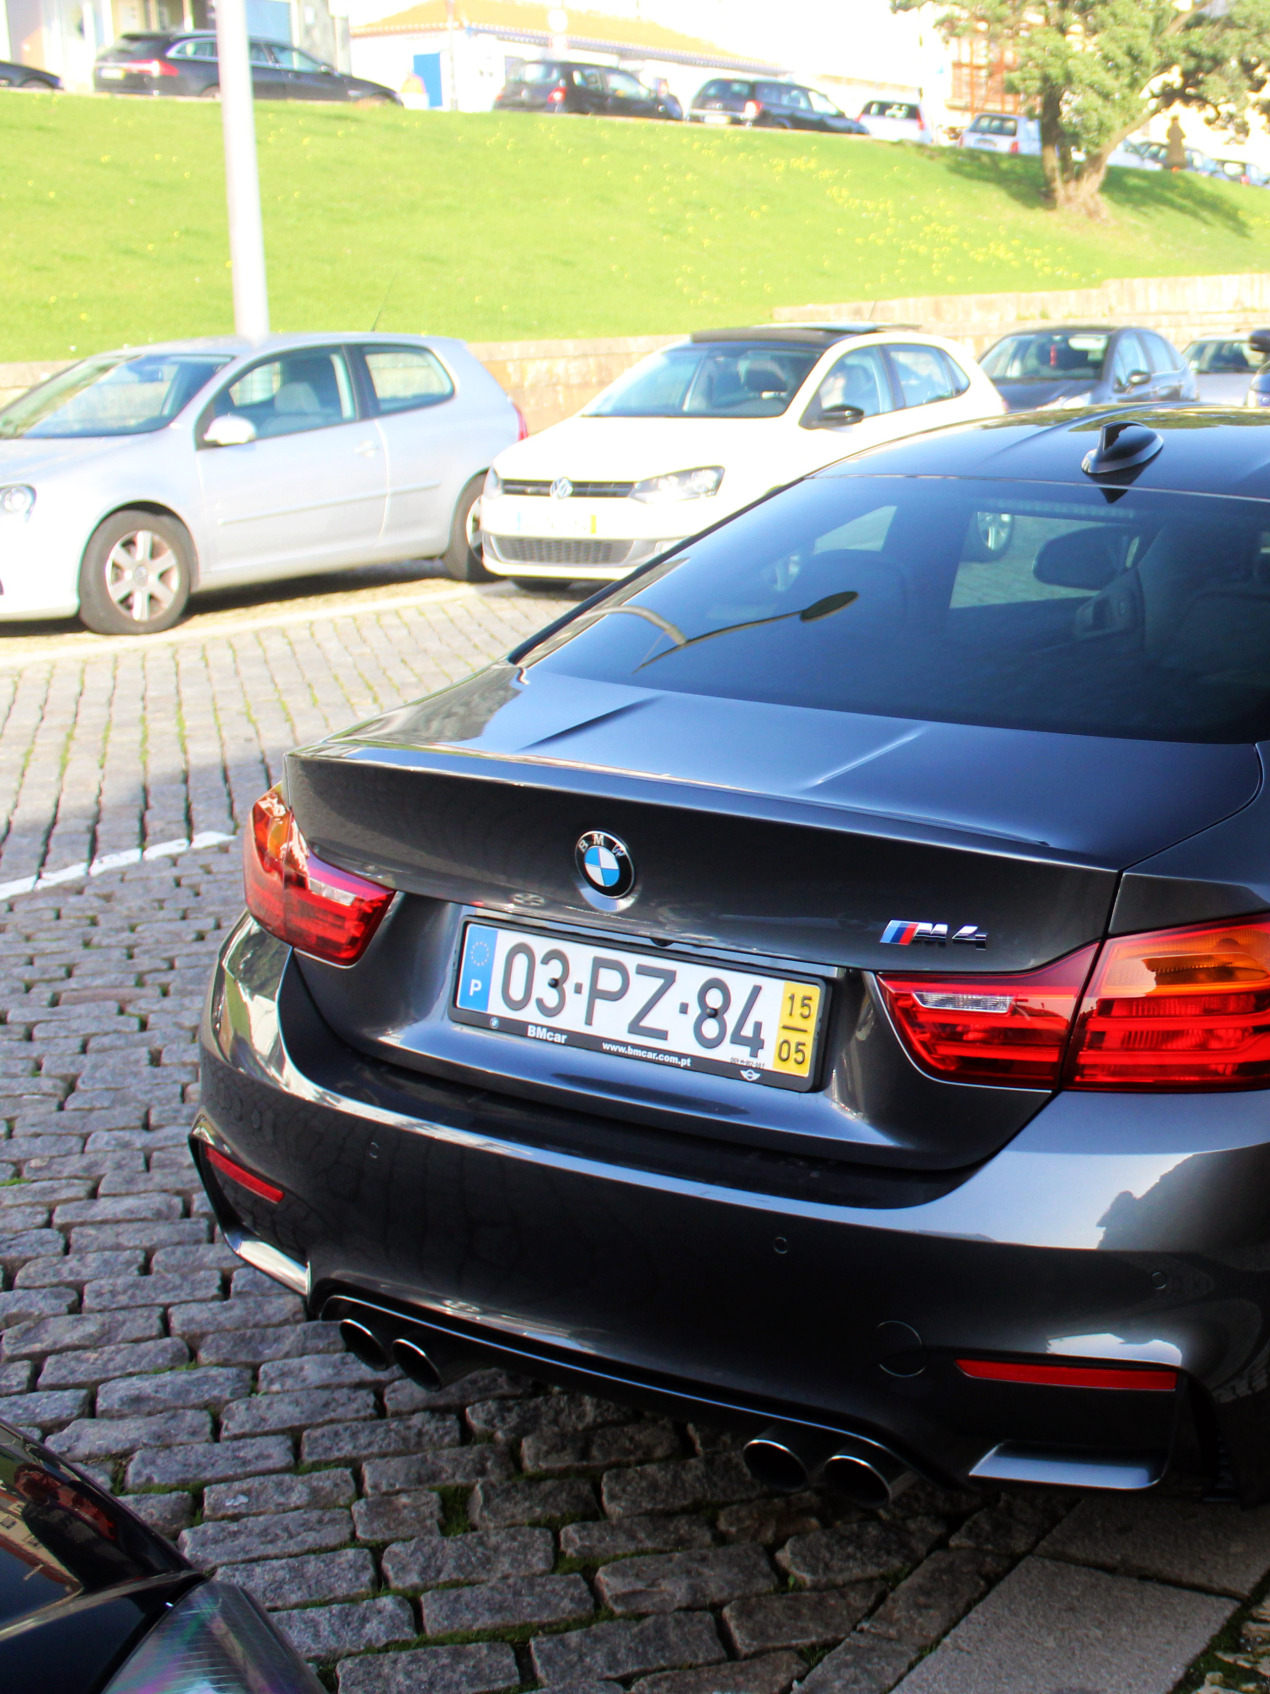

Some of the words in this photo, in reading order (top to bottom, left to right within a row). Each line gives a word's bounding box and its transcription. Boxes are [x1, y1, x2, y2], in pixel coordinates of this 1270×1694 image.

[578, 833, 626, 858] BMW
[911, 922, 988, 951] M4
[469, 979, 482, 996] P
[788, 993, 812, 1019] 15
[527, 1025, 567, 1044] BMcar
[602, 1042, 691, 1067] www.bmcar.com.pt
[778, 1039, 806, 1065] 05
